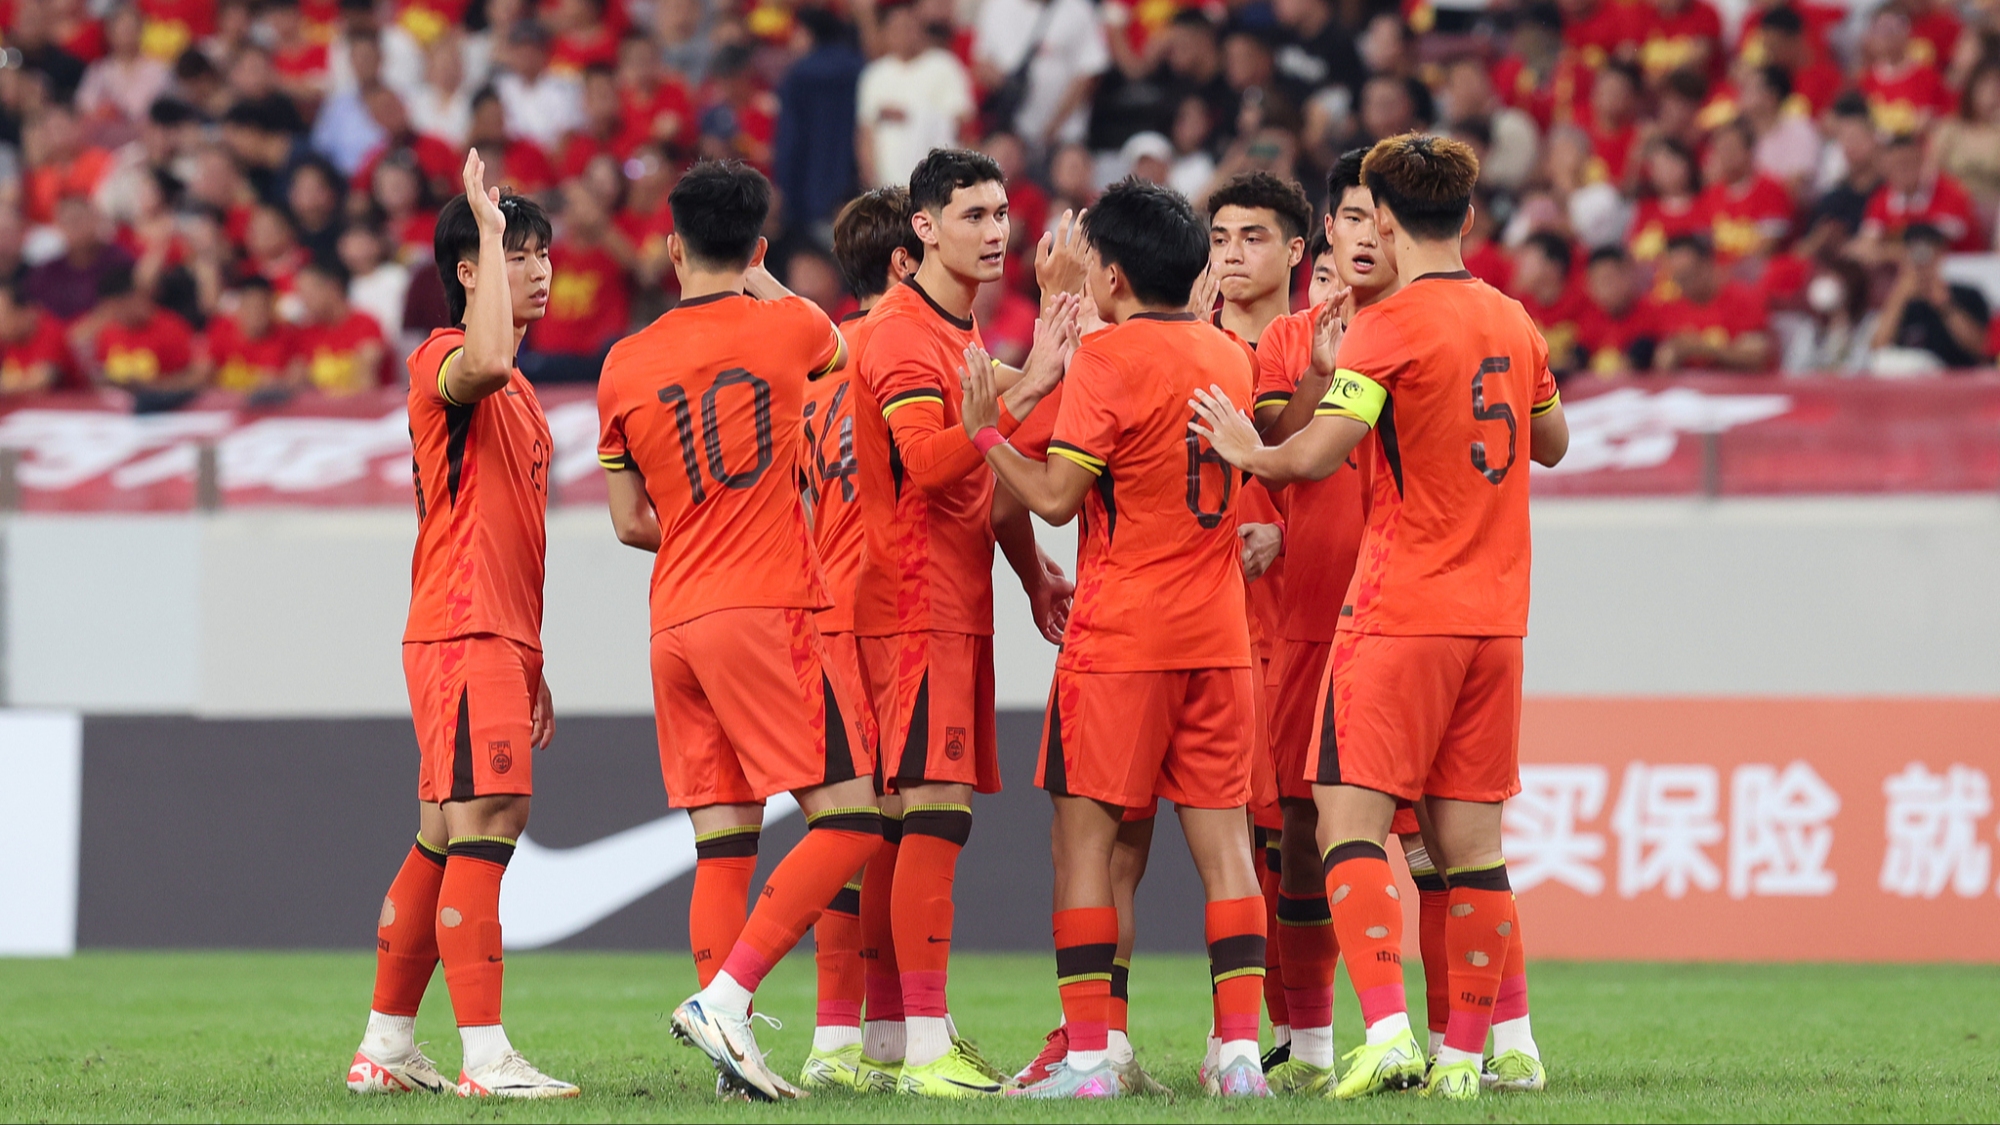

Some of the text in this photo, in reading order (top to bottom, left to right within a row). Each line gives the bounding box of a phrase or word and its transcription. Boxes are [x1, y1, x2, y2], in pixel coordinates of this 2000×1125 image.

[531, 439, 550, 497] 21
[657, 367, 773, 505] 10
[803, 380, 858, 507] 14
[1186, 401, 1232, 529] 6
[1471, 356, 1517, 486] 5
[1504, 761, 2000, 897] 买保险 就
[1461, 991, 1493, 1007] 中国
